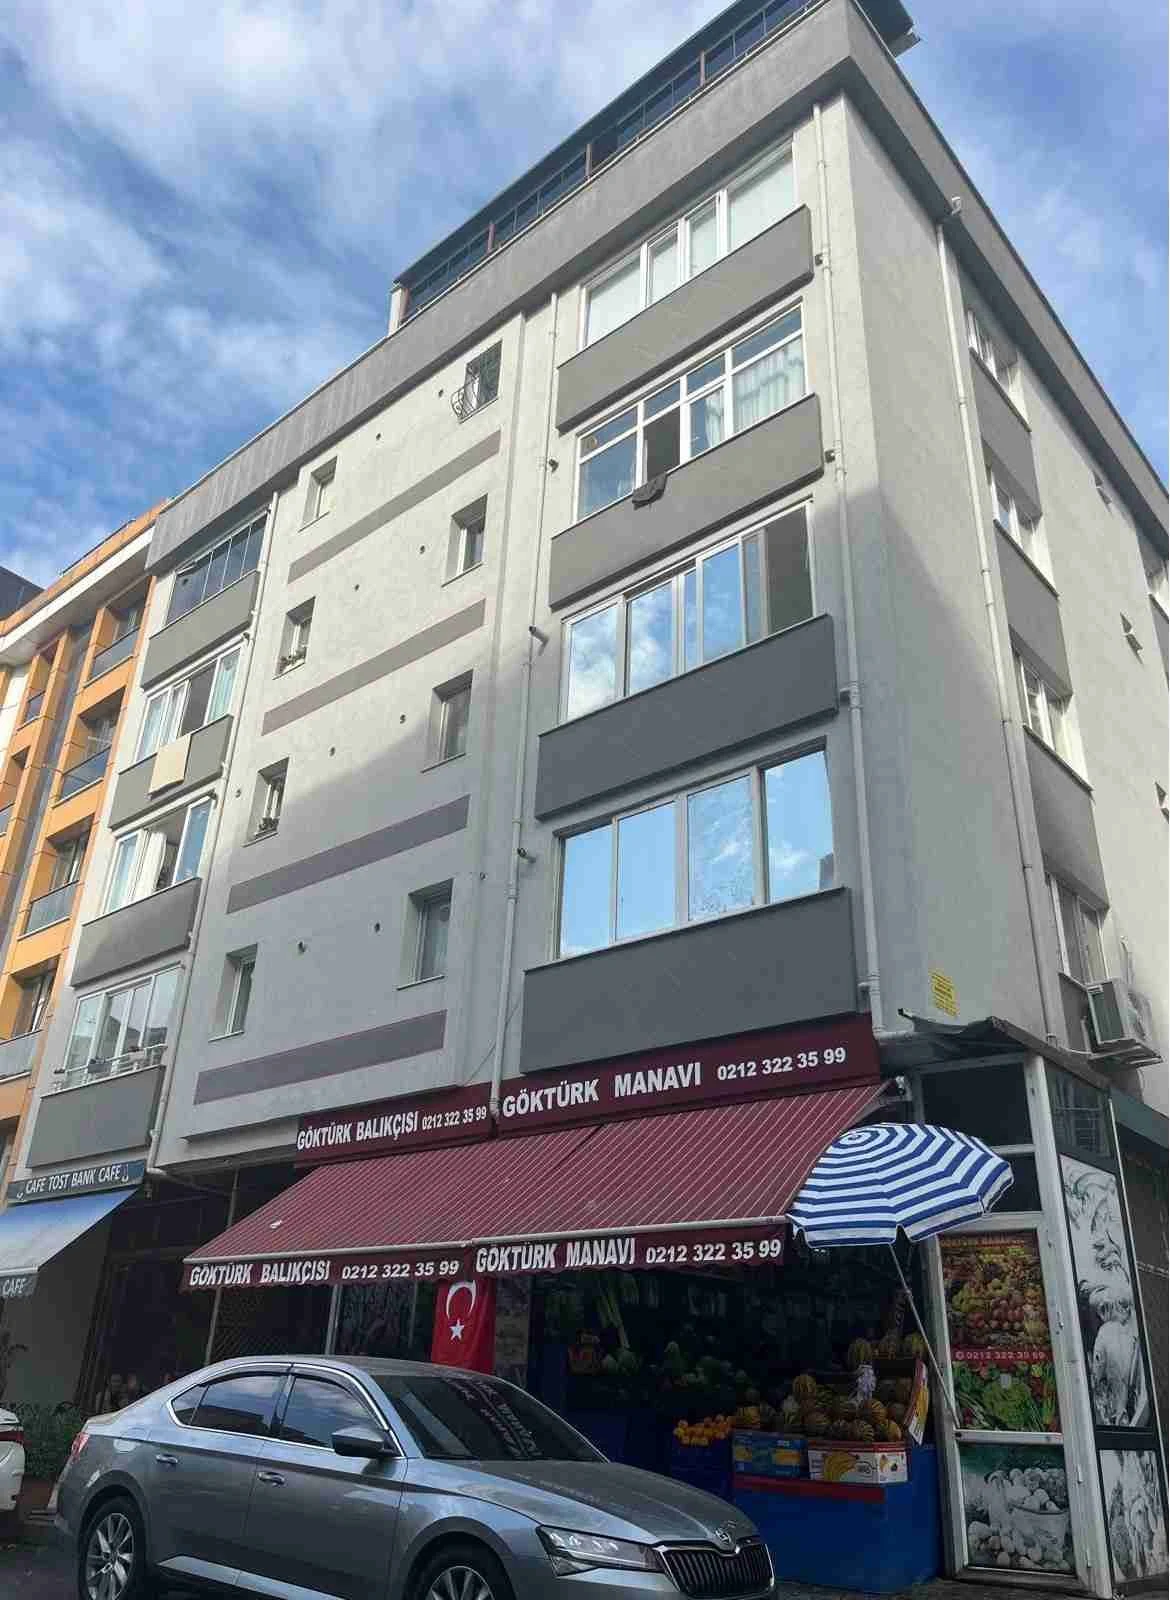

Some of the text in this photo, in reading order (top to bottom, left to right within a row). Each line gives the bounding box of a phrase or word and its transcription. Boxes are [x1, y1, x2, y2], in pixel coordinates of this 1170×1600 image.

[502, 1047, 846, 1118] GÖKTÜRK MANAVI 0212 322 35 99
[297, 1106, 487, 1150] GÖKTÜRK BALIKÇISI 0212 322 35 99
[25, 1165, 121, 1194] CAFE TOST BANK CAFE
[190, 1259, 460, 1286] GÖKTÜRK BALIKÇISI 0212 322 35 99
[476, 1237, 781, 1273] GÖKTÜRK MANAVI 0212 322 35 99
